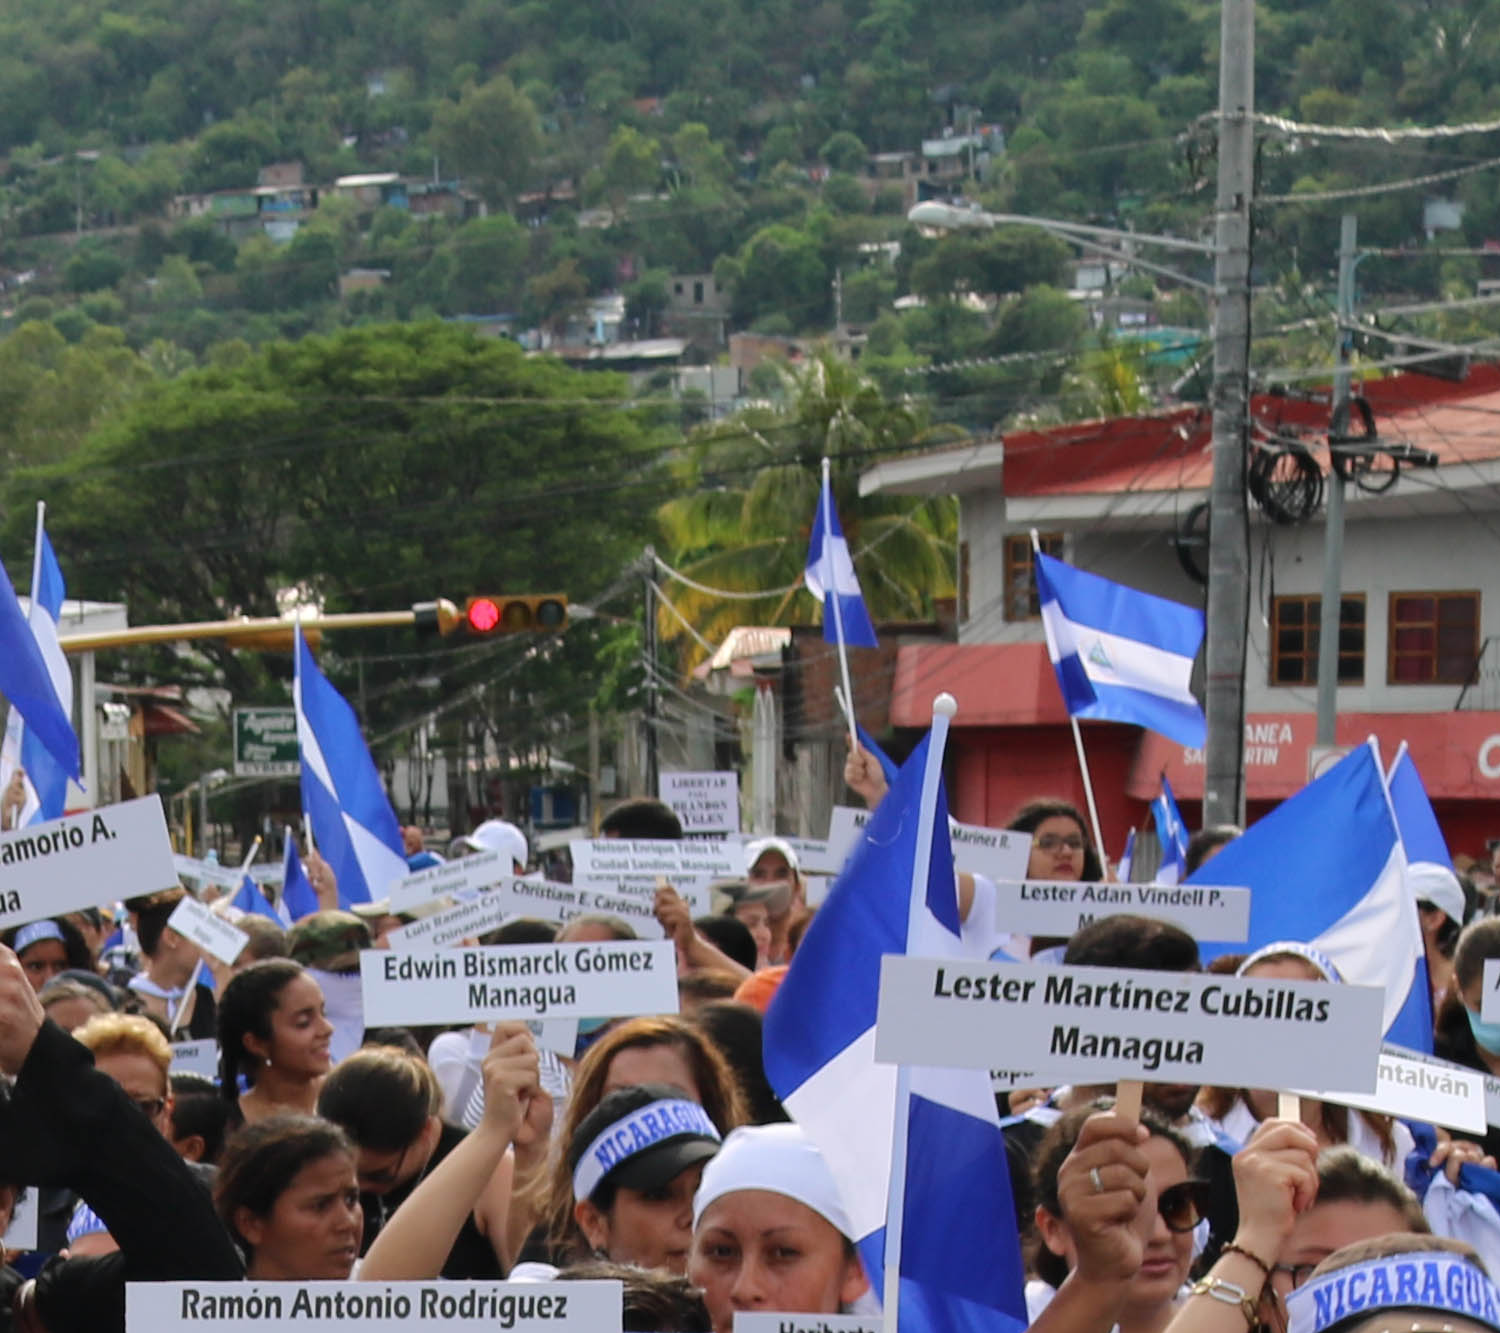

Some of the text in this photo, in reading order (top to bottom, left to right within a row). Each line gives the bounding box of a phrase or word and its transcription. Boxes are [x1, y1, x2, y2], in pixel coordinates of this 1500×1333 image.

[90, 814, 118, 844] A.
[1020, 884, 1078, 902] Lester
[1208, 891, 1226, 908] P.
[432, 909, 511, 945] Chinandeg
[383, 946, 655, 981] Edwin Bismarck Gómez
[467, 983, 578, 1014] Managua
[933, 968, 1331, 1023] Lester Martínez Cubillas
[1049, 1025, 1206, 1067] Managua
[1378, 1062, 1470, 1098] ntalván
[179, 1286, 570, 1326] Ramón Antonio Rodríguez
